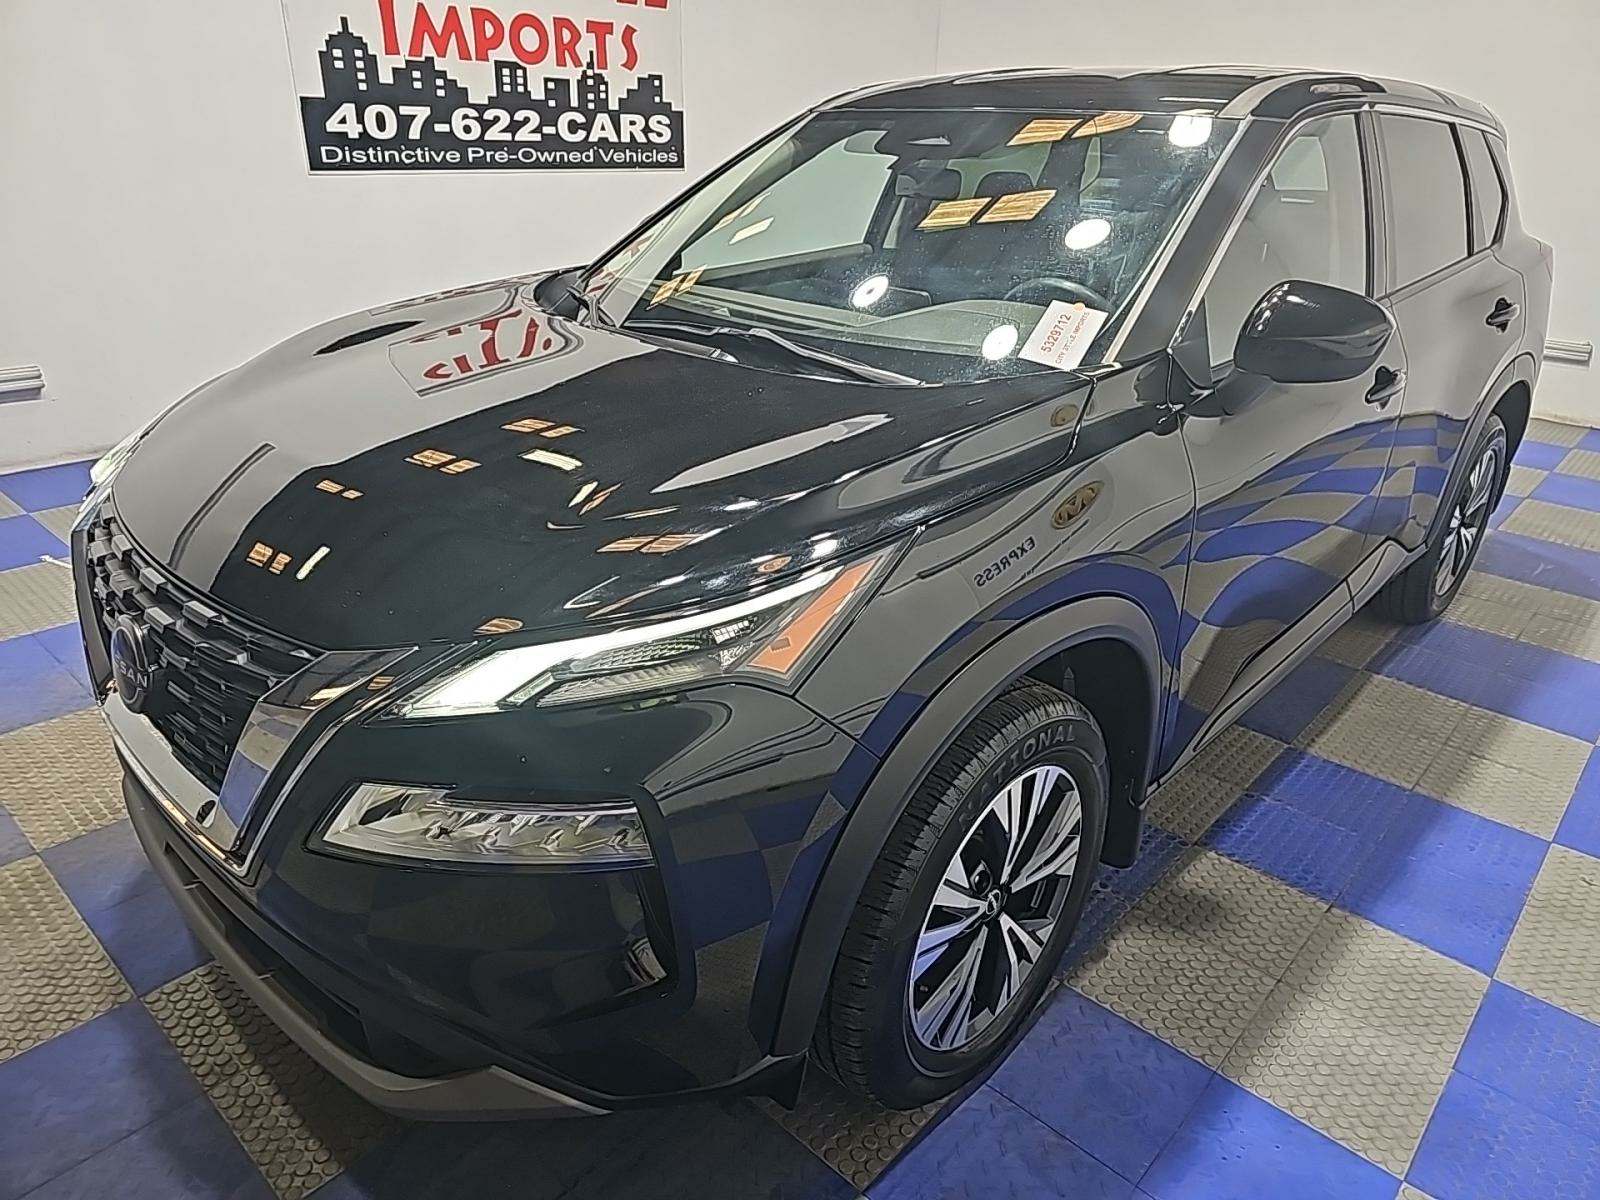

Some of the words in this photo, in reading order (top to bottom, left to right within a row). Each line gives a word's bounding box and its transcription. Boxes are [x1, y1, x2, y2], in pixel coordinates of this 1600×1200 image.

[378, 0, 639, 71] IMPORTS
[325, 103, 673, 145] 407-622-CARS
[320, 145, 461, 165] Distinctive
[468, 146, 595, 164] Pre-Owned
[599, 147, 679, 164] Vehicles
